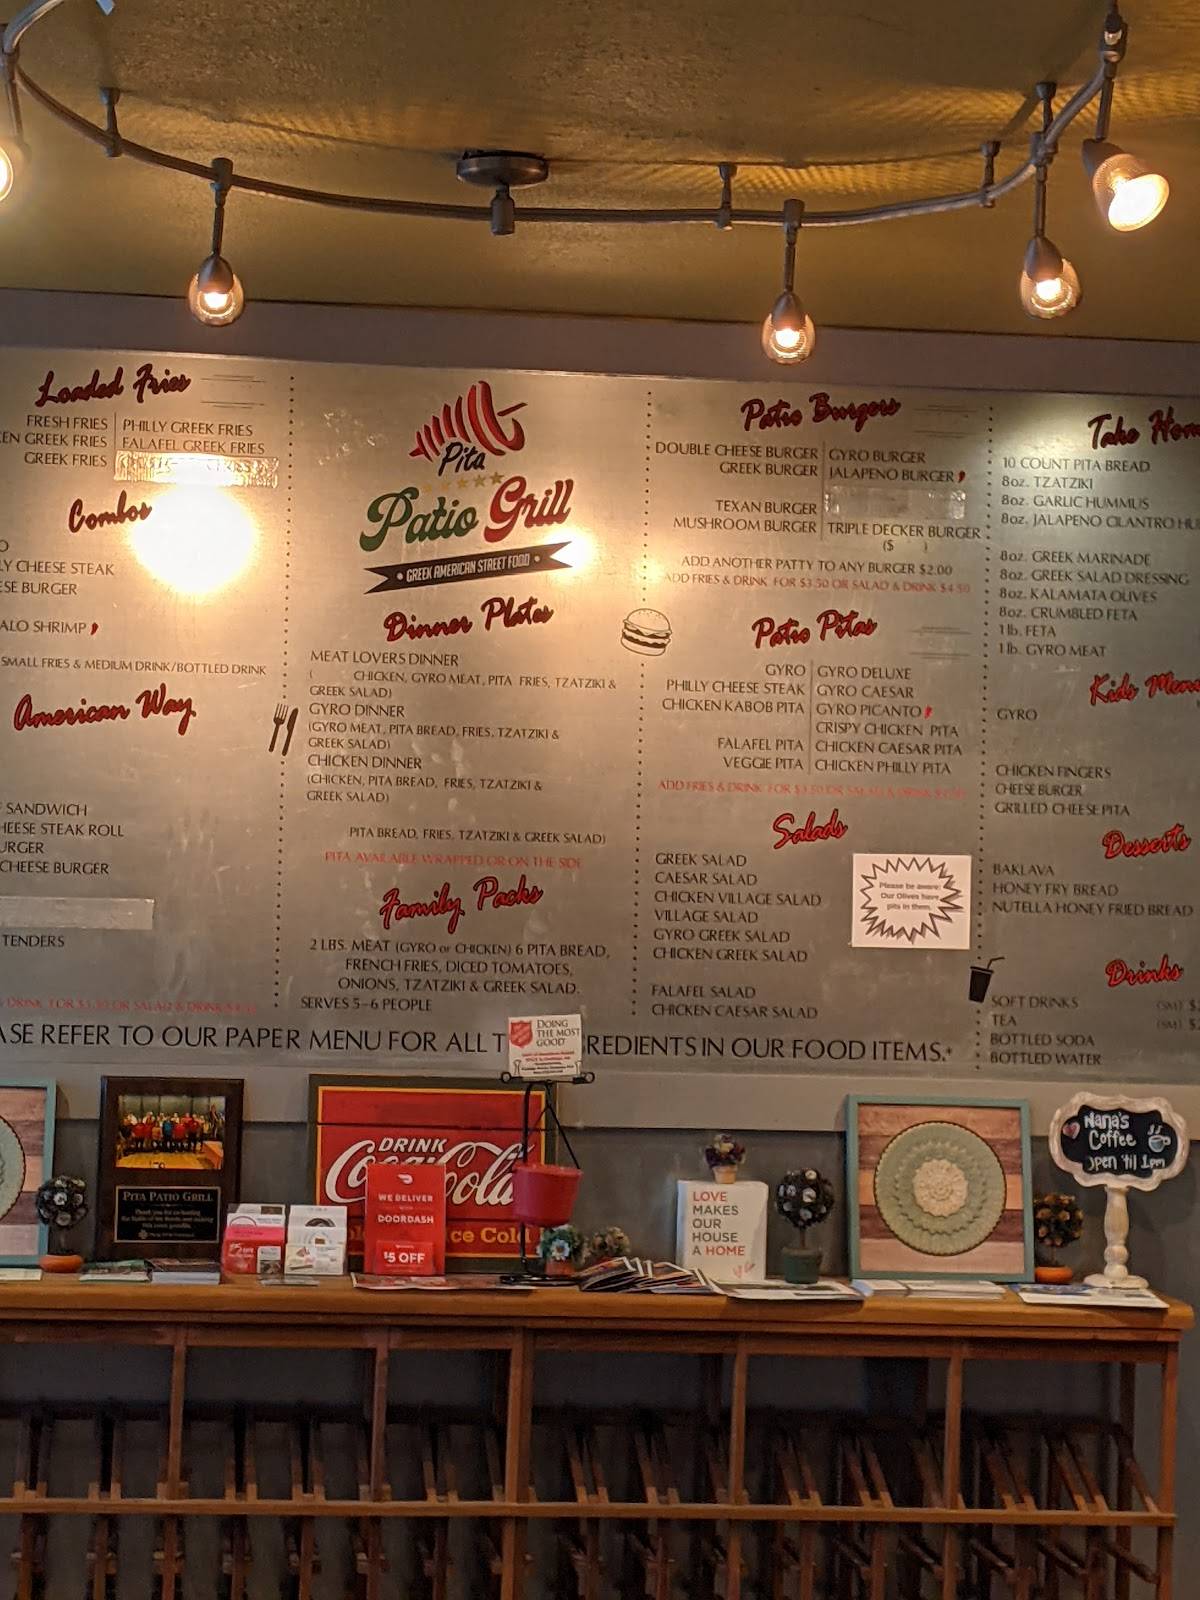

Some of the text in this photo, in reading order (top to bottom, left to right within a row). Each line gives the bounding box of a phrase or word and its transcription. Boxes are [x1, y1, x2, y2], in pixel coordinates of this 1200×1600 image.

[35, 363, 191, 407] Loaded Fries
[741, 392, 901, 432] Patio Burgers
[27, 415, 108, 430] FRESH FRIES
[123, 419, 253, 436] PHILLY GREEK FRIES
[123, 437, 265, 455] FALAFEL GREEK FRIES
[655, 442, 818, 459] DOUBLE CHEESE BURGER
[24, 452, 107, 467] GREEK FRIES
[438, 442, 486, 476] Pita
[829, 450, 925, 463] GYRO BURGER
[720, 463, 818, 477] GREEK BURGER
[1003, 457, 1150, 473] 10 COUNT PITA BREAD
[829, 467, 954, 482] JALAPENO BURGER
[1034, 477, 1093, 489] TZATZIKI
[68, 490, 152, 533] Combos
[359, 476, 574, 552] Patio Grill
[715, 500, 817, 515] TEXAN BURGER
[673, 517, 816, 533] MUSHROOM BURGER
[828, 523, 980, 539] TRIPLE DECKER BURGER
[16, 560, 114, 575] CHEESE STEAK
[406, 553, 529, 582] GREEK AMERICAN STREET FOOD
[682, 556, 709, 567] ADD
[714, 557, 772, 569] ANOTHER
[776, 559, 812, 570] PATTY
[819, 560, 834, 571] TO
[839, 562, 864, 573] ANY
[868, 562, 915, 574] BURGER
[22, 581, 77, 595] BURGER
[384, 596, 554, 642] Dinner Plates
[33, 621, 87, 635] SHRIMP
[752, 609, 877, 649] Patio Pitas
[1, 657, 37, 668] SMALL
[42, 658, 70, 669] FRIES
[74, 660, 81, 669] &
[85, 660, 133, 671] MEDIUM
[232, 663, 266, 675] DRINK
[311, 651, 458, 667] MEAT LOVERS DINNER
[818, 666, 911, 680] GYRO DELUXE
[667, 679, 805, 695] PHILLY CHEESE STEAK
[817, 685, 913, 698] GYRO CAESAR
[1089, 673, 1138, 706] Kids
[14, 683, 196, 736] American Way
[309, 703, 404, 718] GYRO DINNER
[662, 698, 804, 714] CHICKEN KABOB PITA
[816, 703, 921, 718] GYRO PICANTO
[997, 709, 1037, 720] GYRO
[308, 755, 422, 769] CHICKEN DINNER
[7, 803, 87, 816] SANDWICH
[41, 823, 124, 837] STEAK ROLL
[773, 809, 848, 850] Salads
[1102, 823, 1191, 859] Desserts
[53, 862, 109, 874] BURGER
[655, 854, 747, 867] GREEK SALAD
[380, 874, 543, 934] Family Packs
[3, 935, 64, 947] TENDERS
[346, 958, 400, 971] FRENCH
[446, 961, 487, 973] DICED
[1105, 954, 1183, 987] Drinks
[301, 998, 349, 1010] SERVES
[382, 999, 432, 1012] PEOPLE
[537, 1020, 568, 1028] DOING
[556, 1028, 579, 1036] MOST
[991, 1033, 1051, 1046] BOTTLED
[41, 1024, 110, 1046] REFER
[118, 1025, 154, 1046] TO
[162, 1026, 217, 1047] OUR
[225, 1027, 300, 1049] PAPER
[310, 1030, 381, 1050] MENU
[388, 1031, 438, 1051] FOR
[446, 1032, 488, 1053] ALL
[702, 1037, 724, 1056] IN
[731, 1037, 784, 1058] OUR
[792, 1039, 866, 1060] FOOD
[991, 1052, 1100, 1065] BOTTLED WATER
[379, 1137, 447, 1152] DRINK
[1089, 1130, 1136, 1150] Coffee
[123, 1192, 146, 1201] PITA
[150, 1192, 179, 1201] PATIO
[693, 1191, 727, 1201] LOVE
[693, 1205, 738, 1215] MAKES
[378, 1215, 433, 1223] DOORDASH
[692, 1218, 721, 1229] OUR
[693, 1232, 737, 1242] HOUSE
[399, 1253, 425, 1263] OFF
[692, 1246, 745, 1256] A HOME
